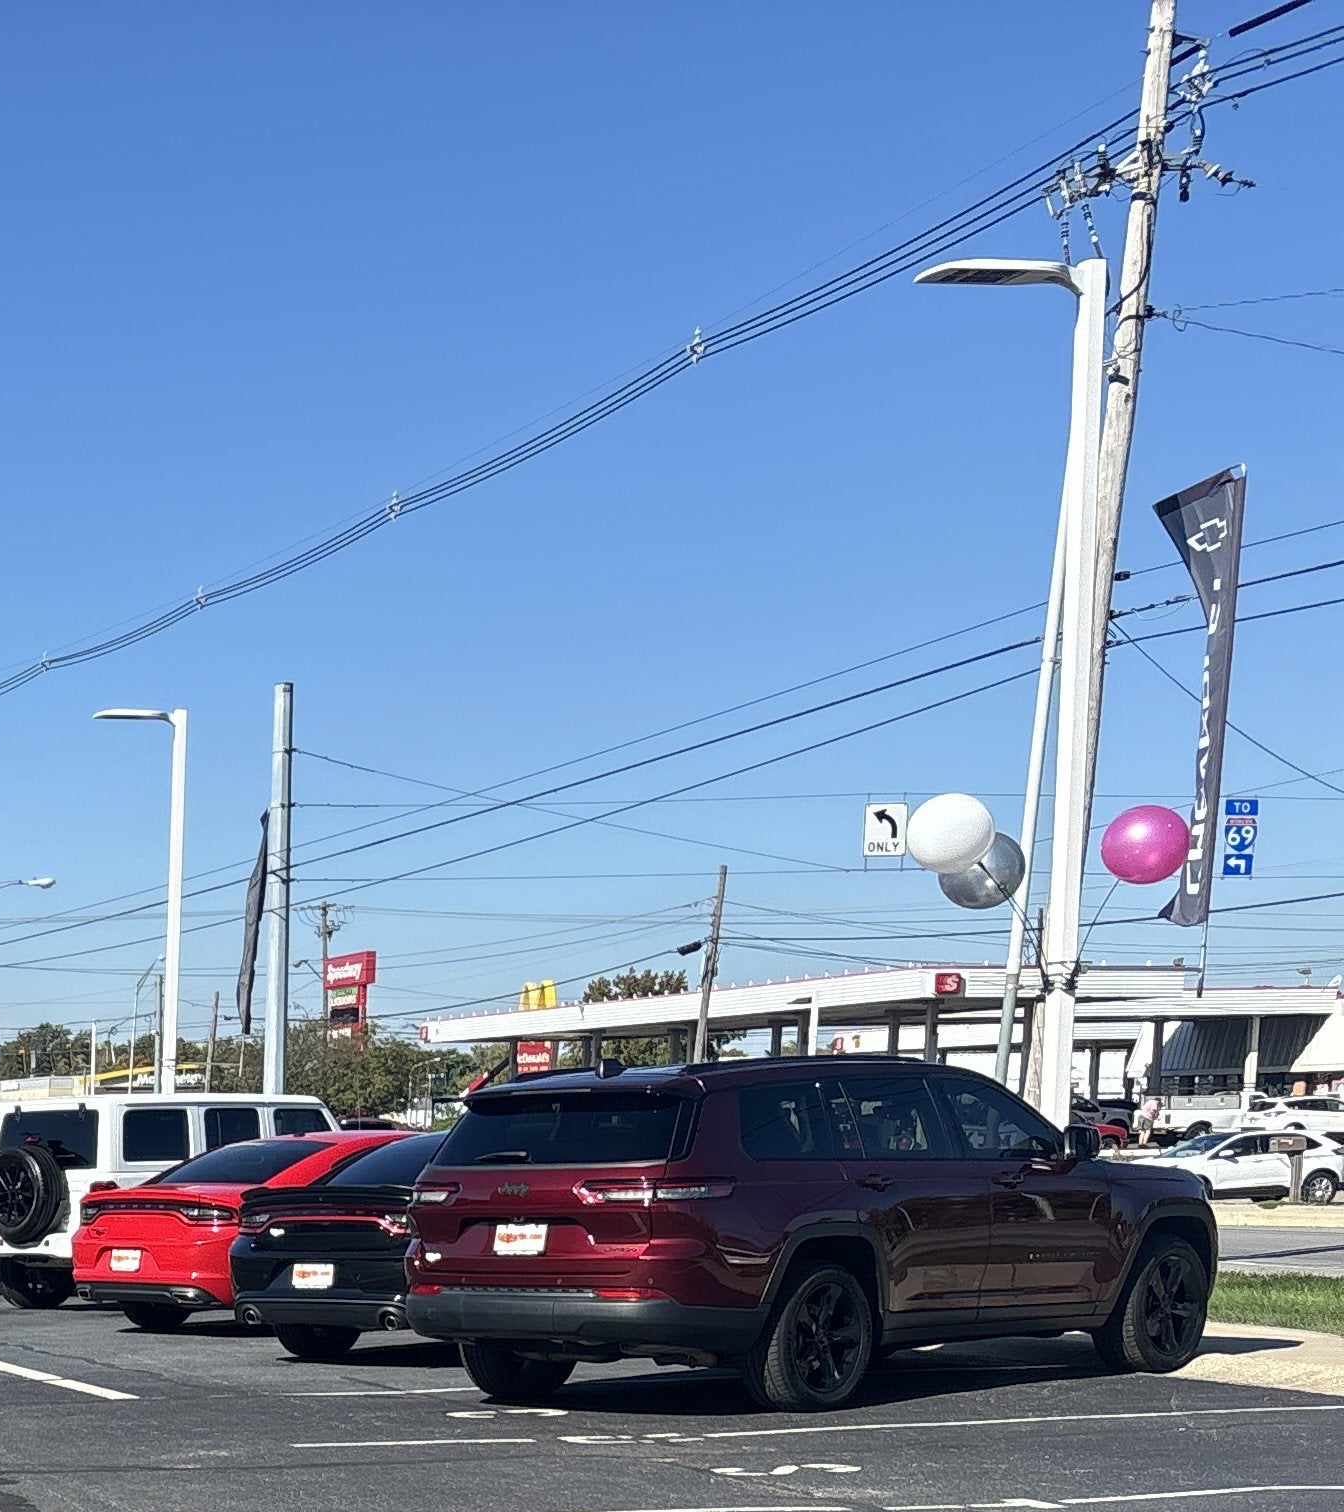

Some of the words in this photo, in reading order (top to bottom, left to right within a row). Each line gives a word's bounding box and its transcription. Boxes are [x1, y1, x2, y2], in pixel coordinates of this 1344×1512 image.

[1234, 802, 1250, 813] TO
[1227, 826, 1254, 846] 69
[868, 841, 900, 852] ONLY
